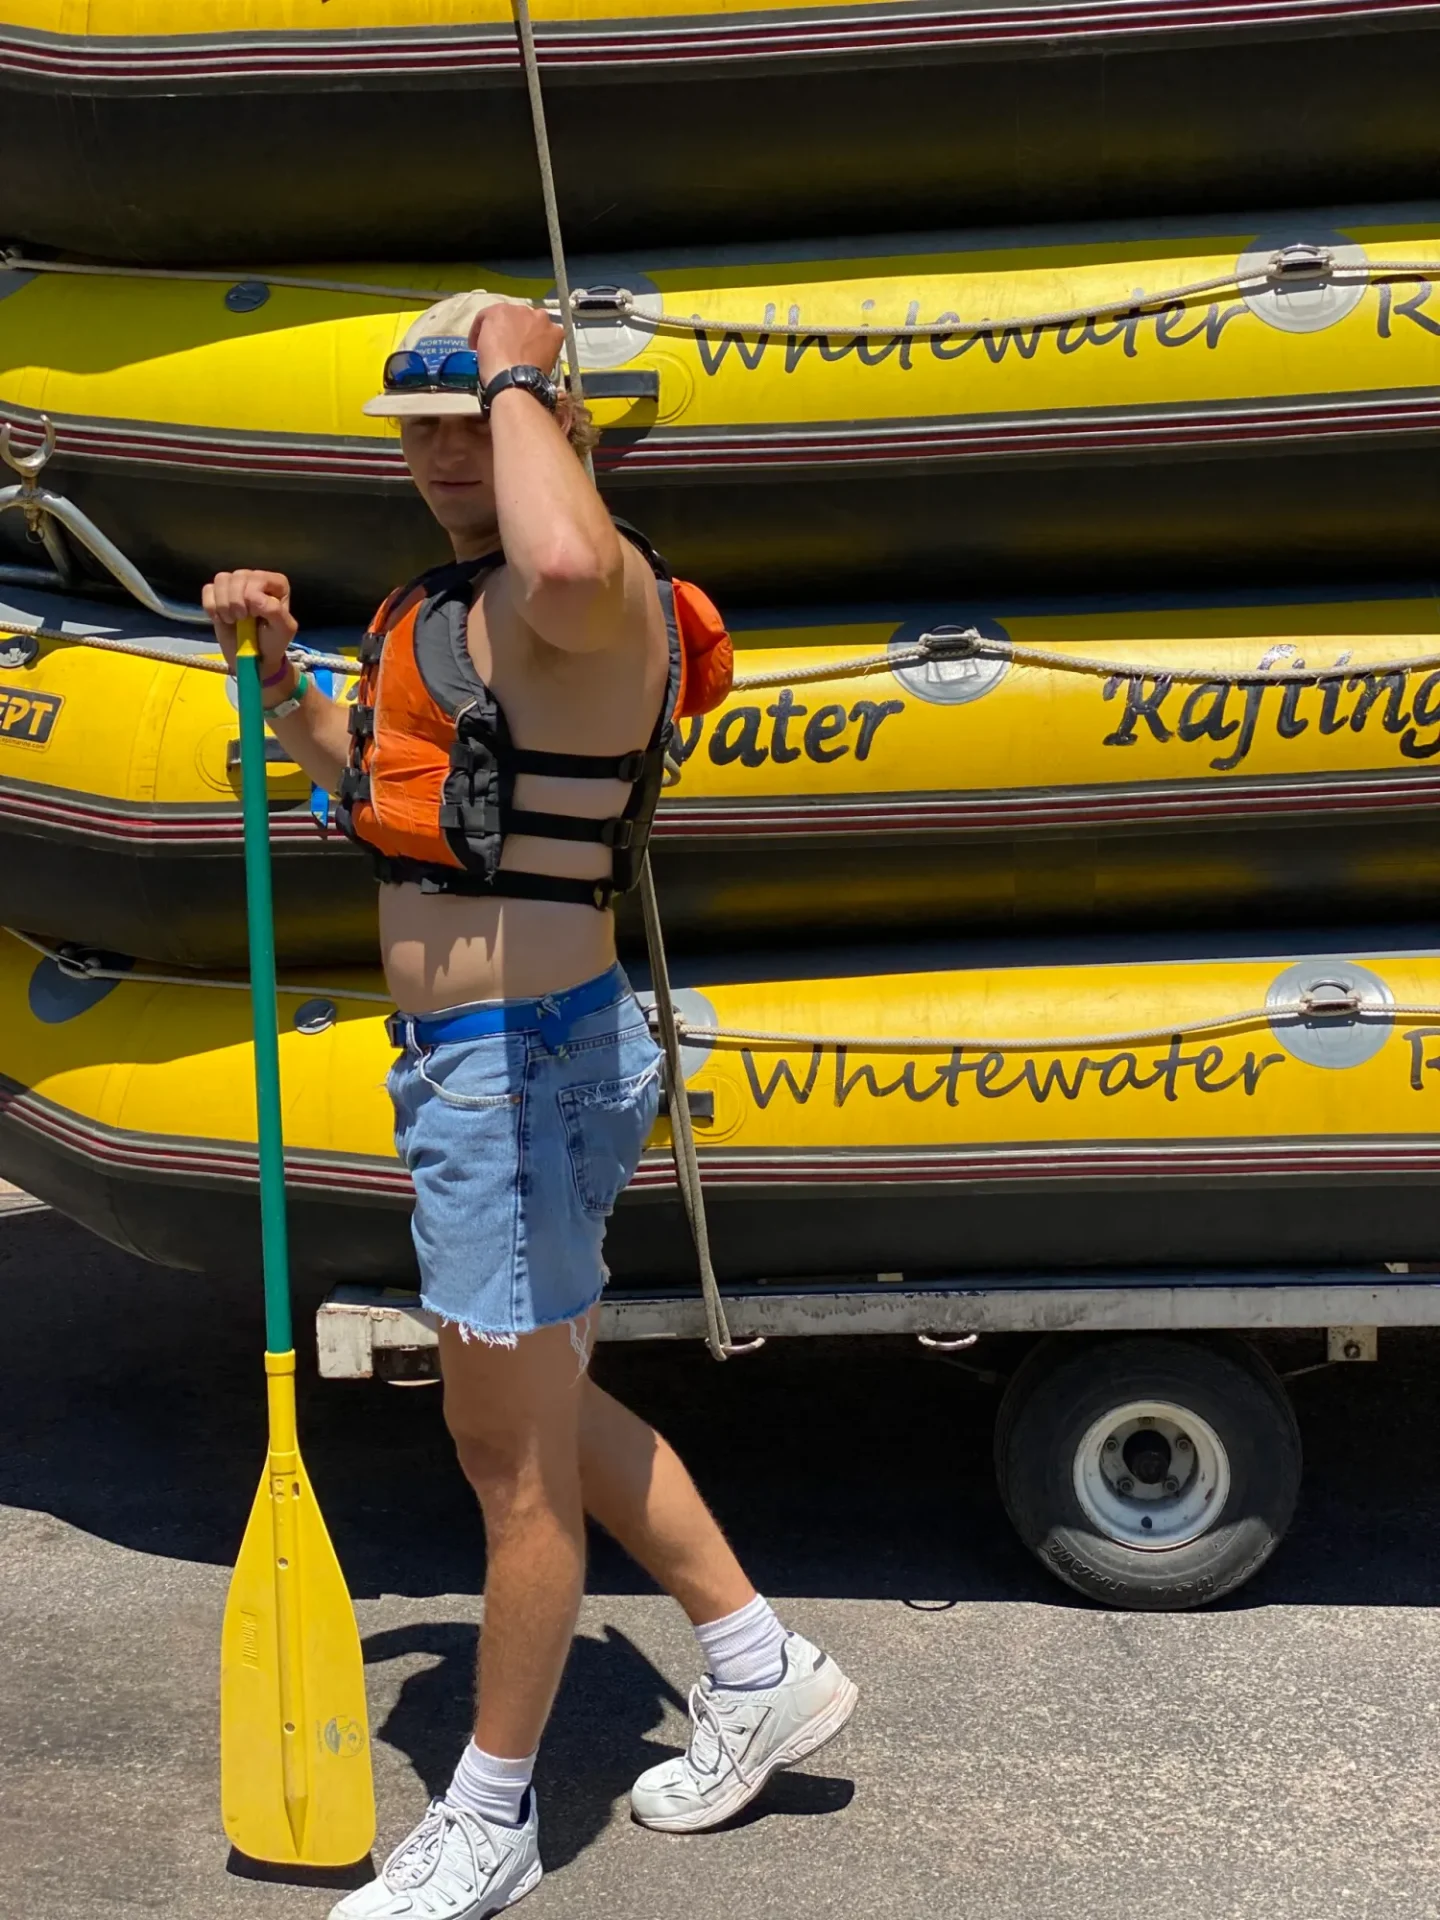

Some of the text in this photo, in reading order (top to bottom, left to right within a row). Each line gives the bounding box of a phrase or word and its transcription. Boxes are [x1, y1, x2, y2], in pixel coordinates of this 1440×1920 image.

[419, 339, 468, 347] NORTHWE
[692, 287, 1250, 376] Whitewater
[740, 1034, 1286, 1110] Whitewater
